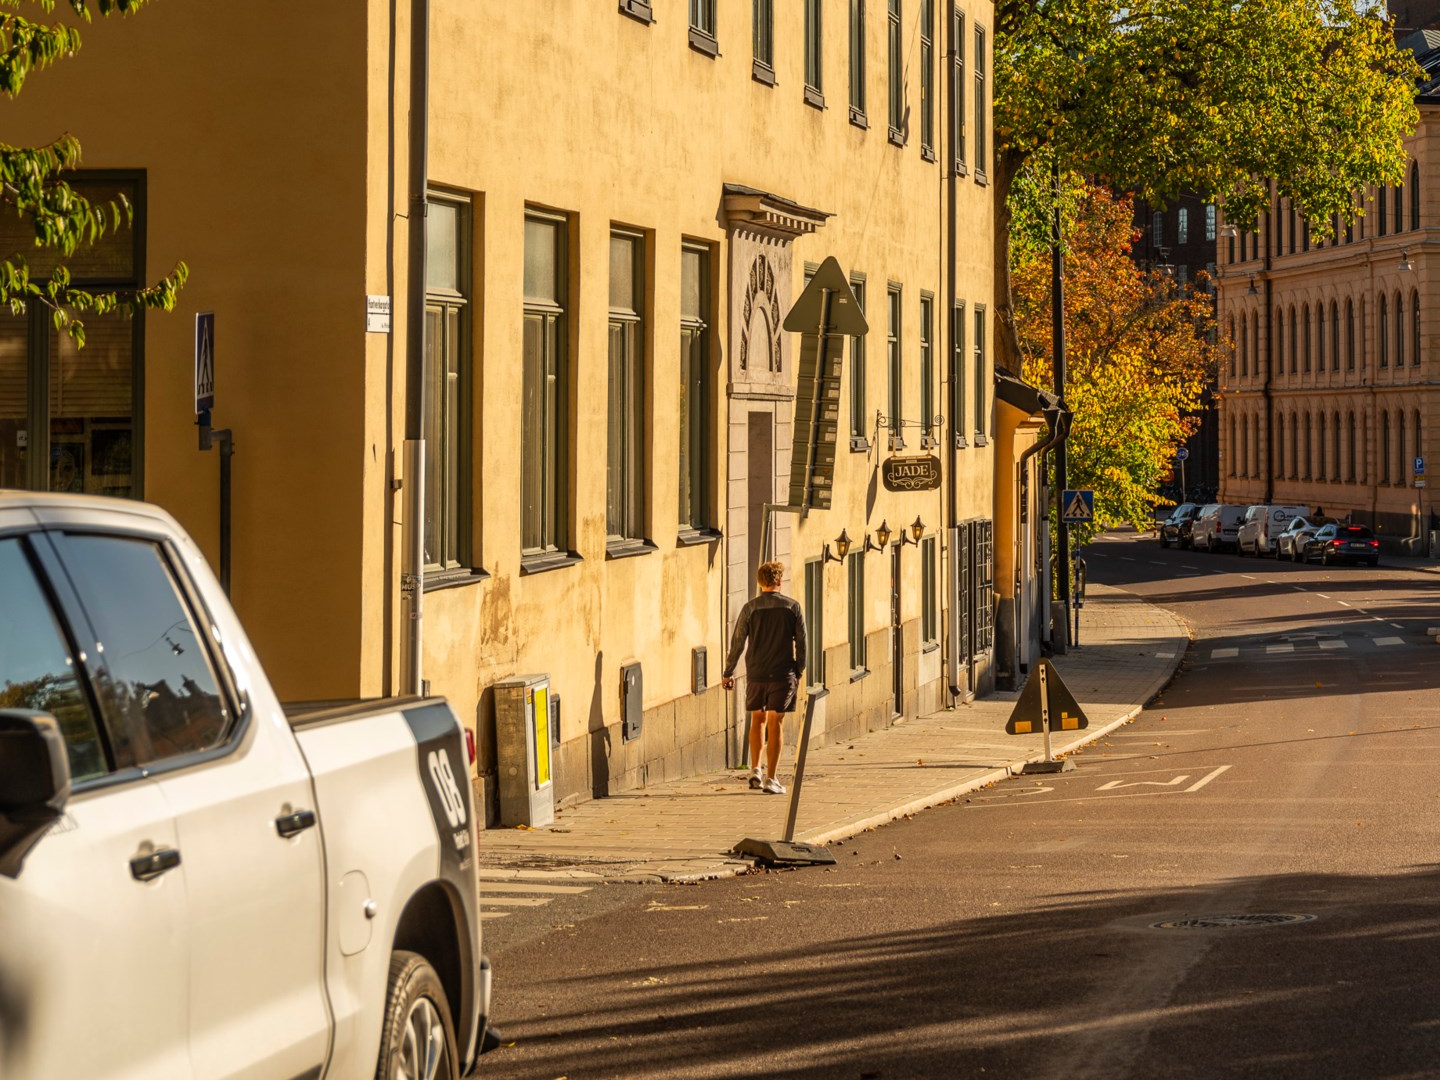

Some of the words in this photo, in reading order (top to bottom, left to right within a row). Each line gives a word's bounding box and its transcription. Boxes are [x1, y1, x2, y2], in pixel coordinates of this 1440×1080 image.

[1416, 458, 1422, 469] P
[895, 465, 929, 477] JADE
[427, 749, 466, 828] 08
